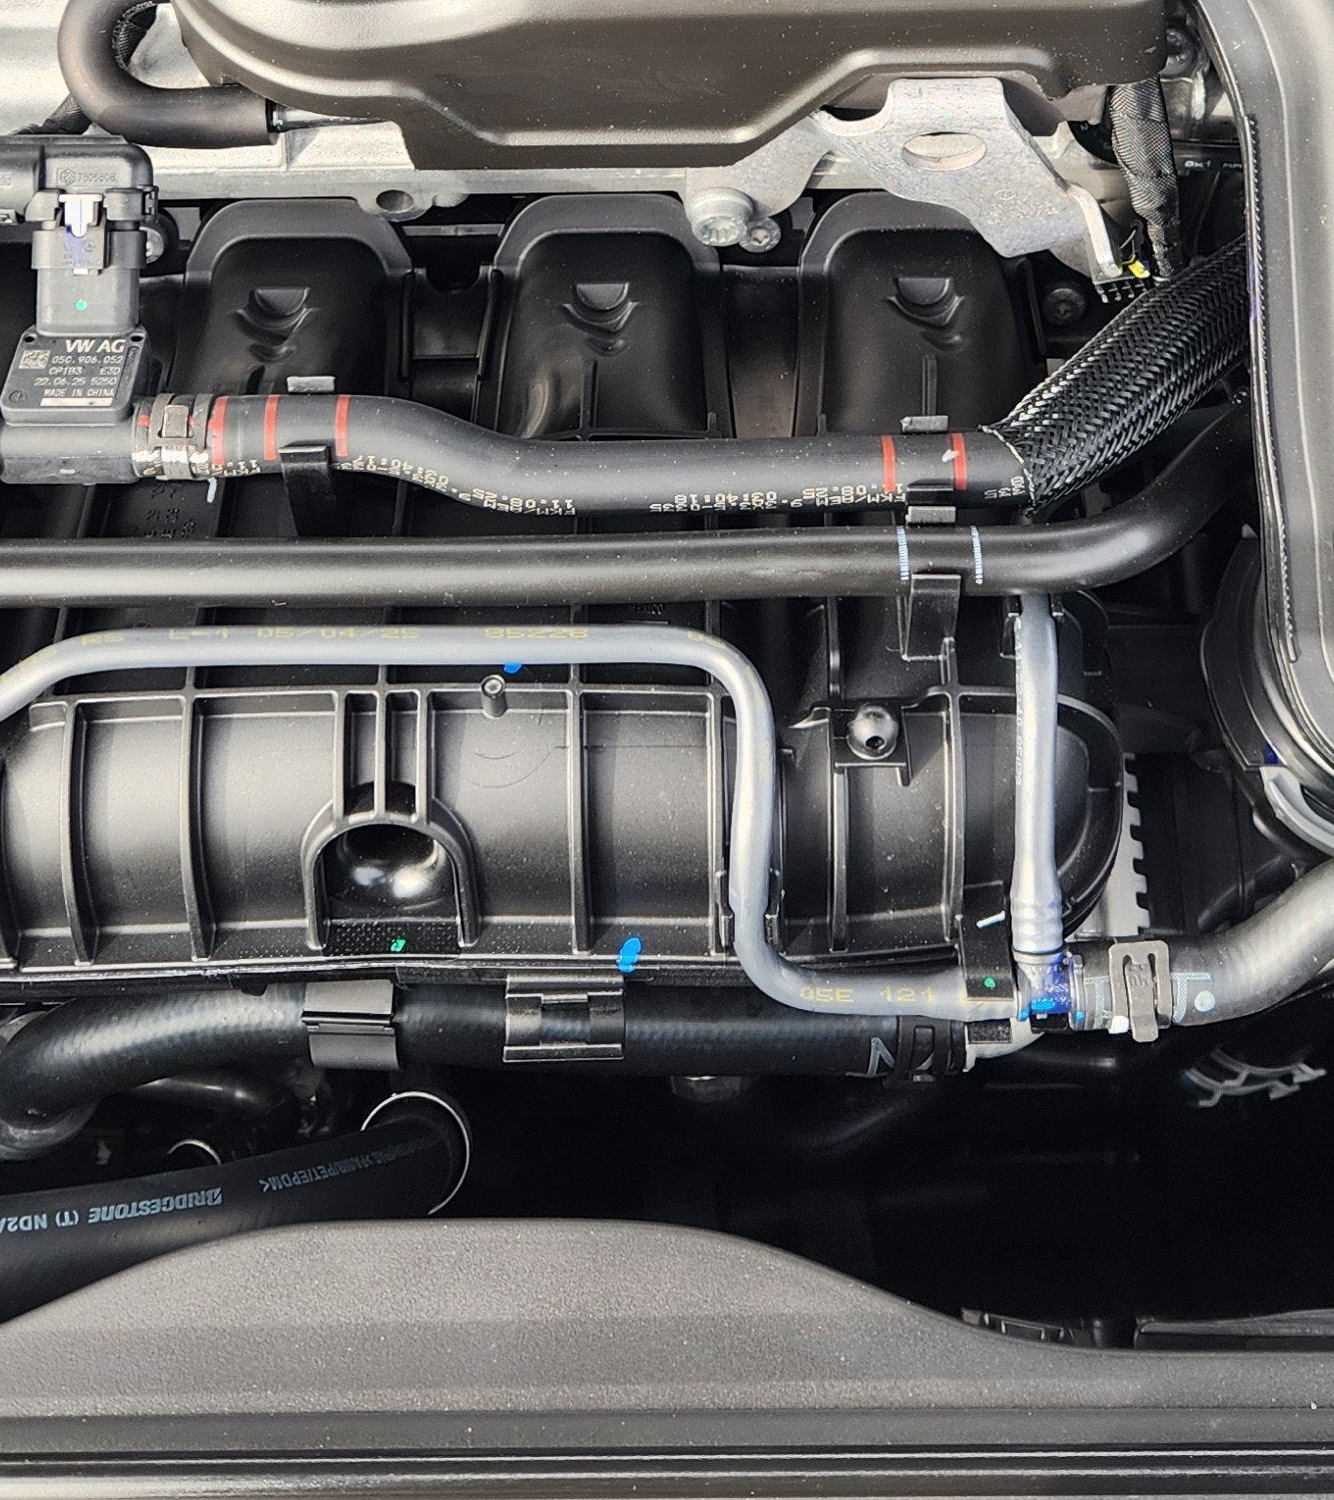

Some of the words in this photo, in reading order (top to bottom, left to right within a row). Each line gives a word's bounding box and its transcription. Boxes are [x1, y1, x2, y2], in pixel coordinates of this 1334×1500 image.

[65, 338, 96, 354] VW
[96, 338, 127, 354] AG
[42, 388, 68, 397] MADE
[86, 387, 115, 397] CHINA
[799, 987, 855, 1003] 05E
[879, 987, 935, 1003] 121
[88, 1187, 223, 1225] BRIDGESTONE
[55, 1210, 80, 1228] (T)
